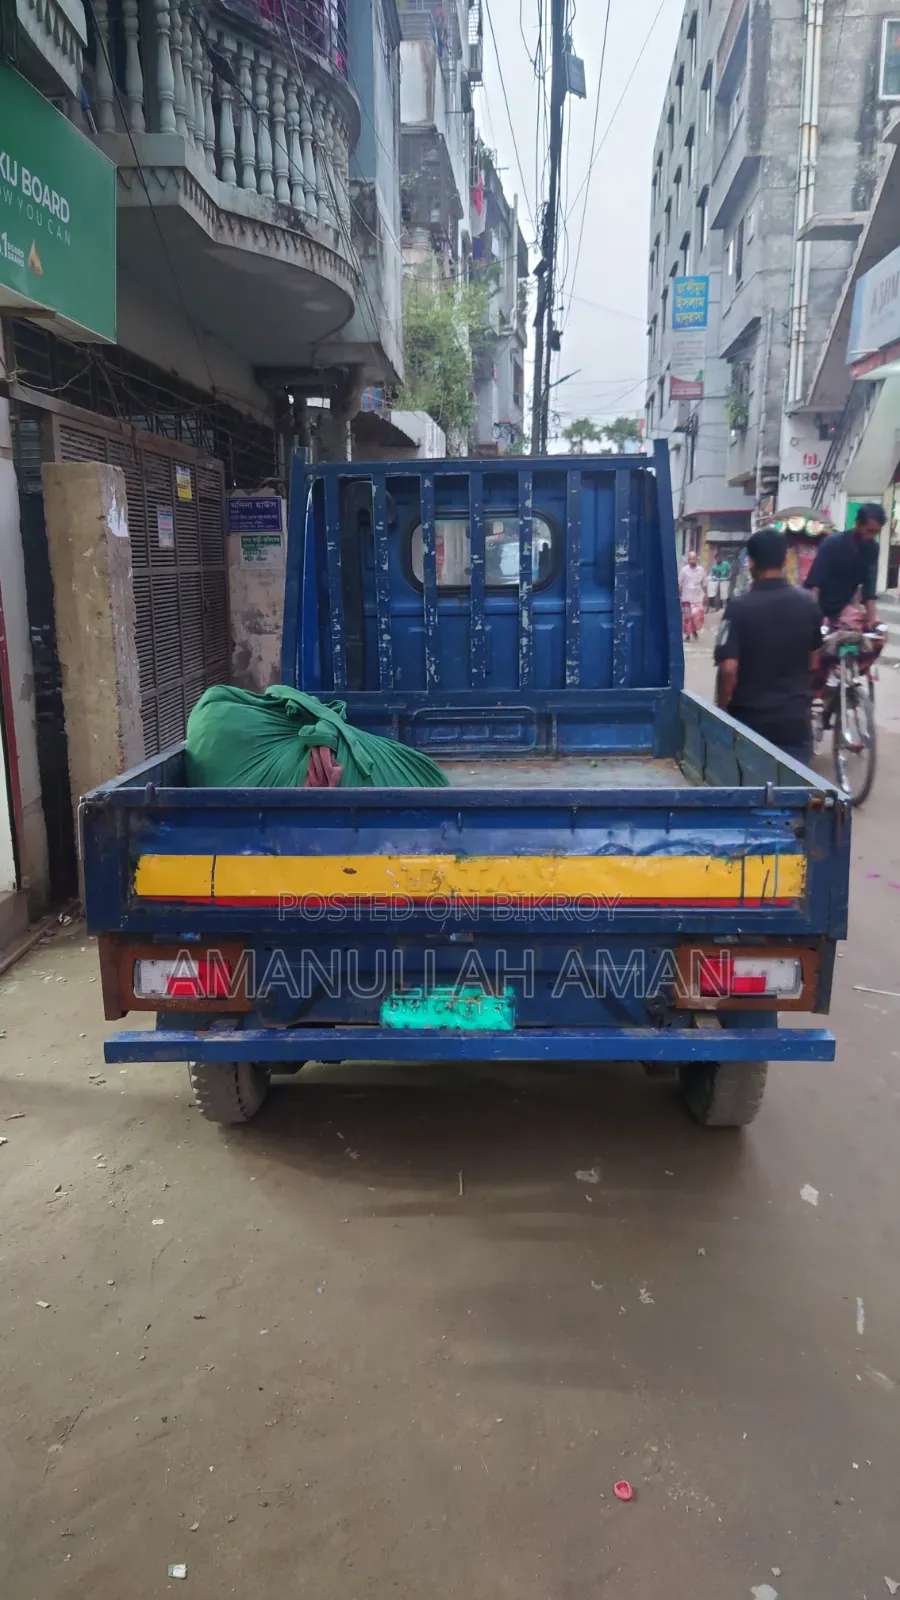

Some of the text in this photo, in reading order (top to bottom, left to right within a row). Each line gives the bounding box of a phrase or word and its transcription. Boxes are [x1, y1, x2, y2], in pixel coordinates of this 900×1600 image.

[18, 196, 43, 226] YOU
[47, 219, 71, 247] CAN
[22, 166, 70, 223] BOARD
